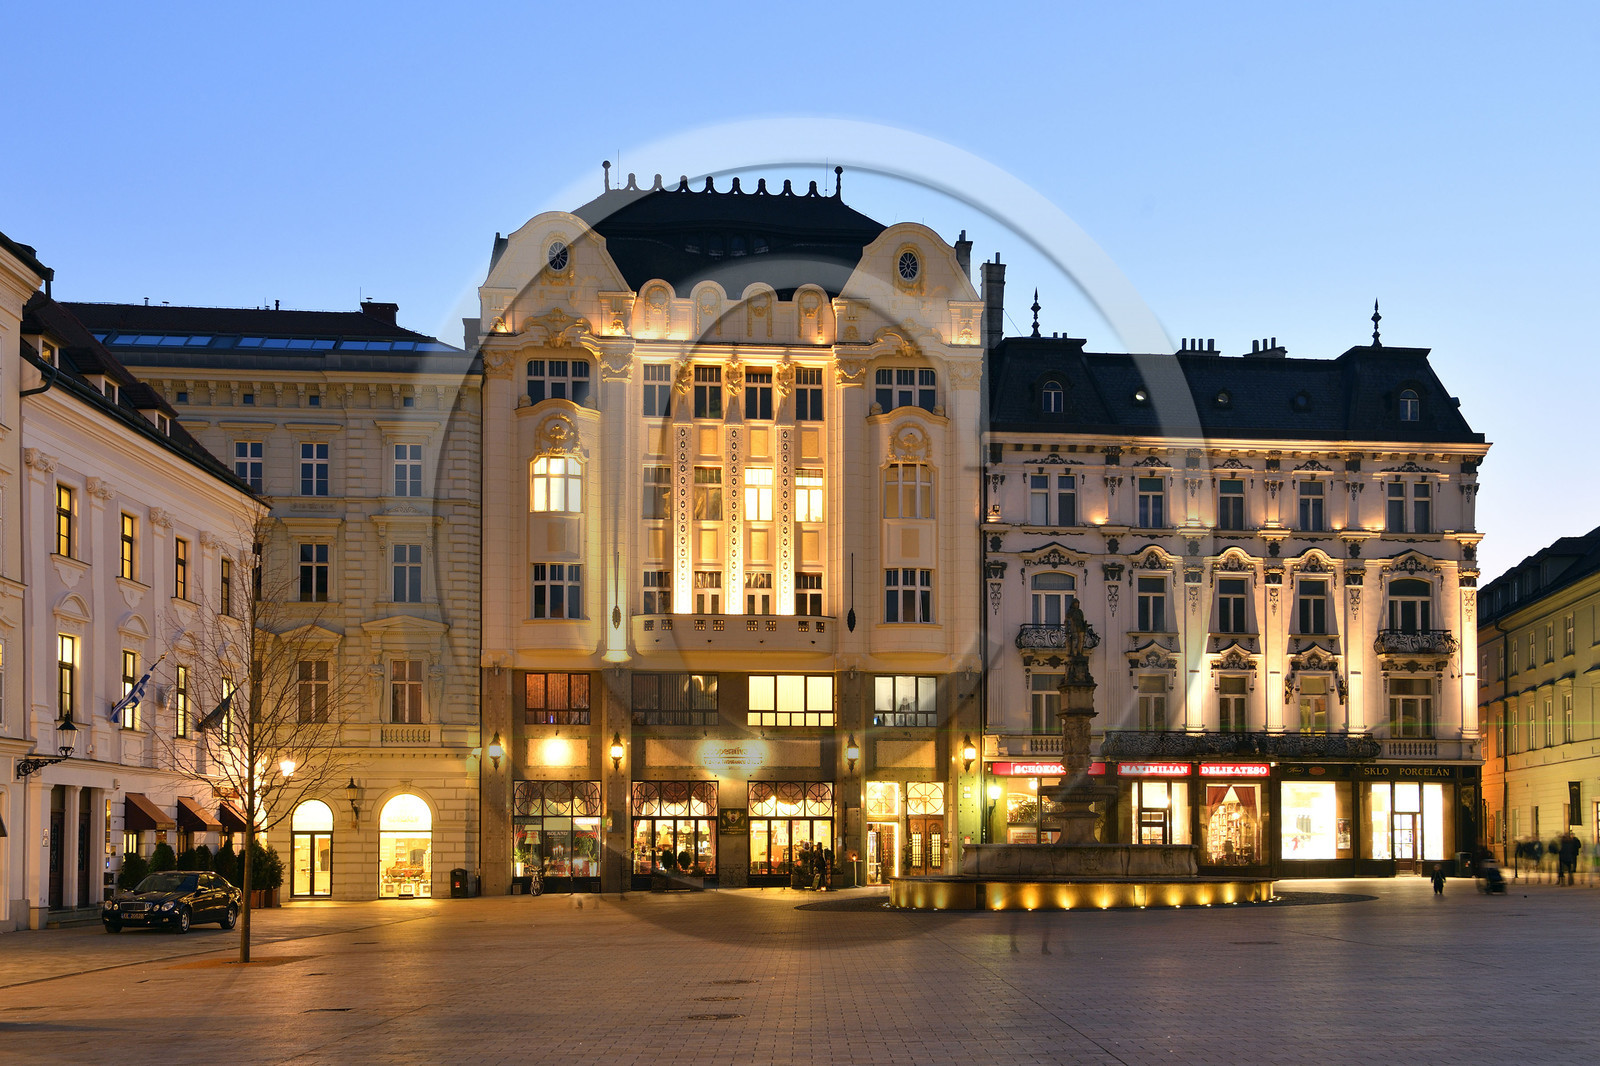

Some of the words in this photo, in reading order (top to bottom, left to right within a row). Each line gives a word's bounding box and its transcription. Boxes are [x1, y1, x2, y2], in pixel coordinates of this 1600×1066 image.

[1120, 765, 1188, 774] MAXIMILIAN
[1201, 766, 1267, 775] DELIKATESO
[1364, 767, 1390, 776] SKLO
[1400, 766, 1450, 776] PORCELÁN
